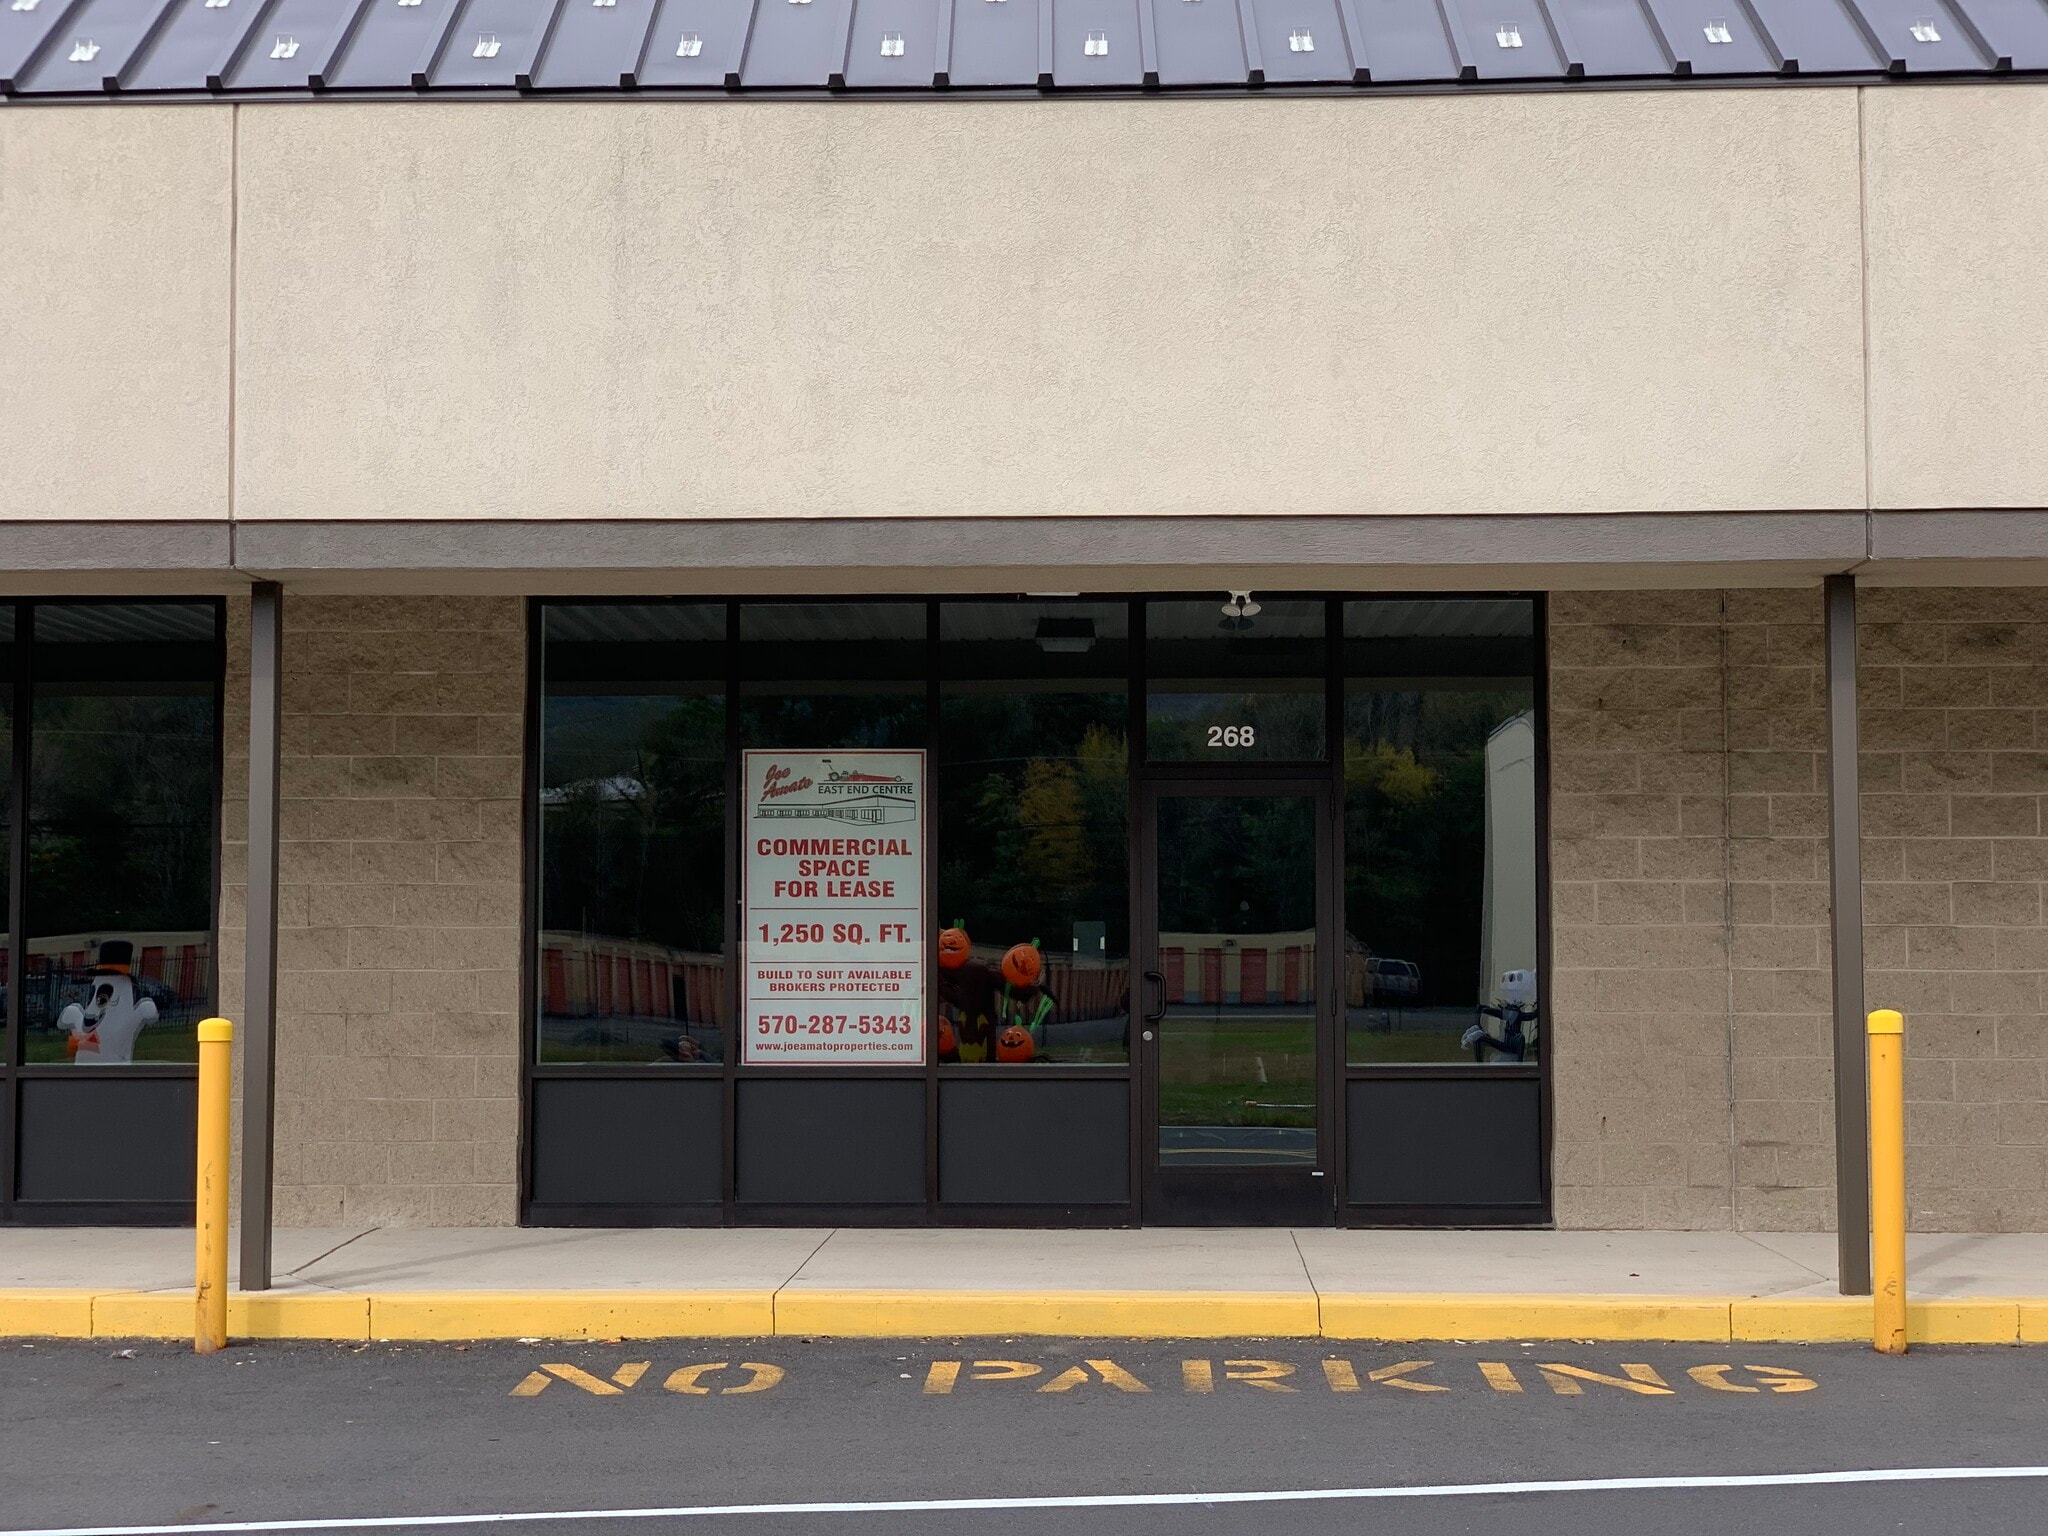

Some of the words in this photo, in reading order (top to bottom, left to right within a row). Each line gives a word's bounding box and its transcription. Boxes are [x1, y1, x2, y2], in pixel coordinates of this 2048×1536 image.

[1207, 726, 1255, 747] 268
[763, 764, 791, 789] Joe
[760, 777, 813, 802] Amato
[818, 785, 844, 794] EAST
[847, 785, 869, 794] END
[872, 785, 912, 794] CENTRE
[757, 839, 912, 856] COMMERCIAL
[799, 860, 869, 877] SPACE
[774, 881, 818, 897] FOR
[828, 881, 894, 897] LEASE
[758, 923, 823, 946] 1,250
[833, 923, 871, 945] SQ.
[880, 924, 911, 943] FT.
[758, 970, 793, 979] BUILD
[797, 970, 812, 979] TO
[817, 970, 843, 979] SUIT
[848, 970, 911, 979] AVAILABLE
[770, 983, 825, 992] BROKERS
[830, 983, 900, 992] PROTECTED
[758, 1015, 911, 1034] 570-287-5343
[756, 1042, 913, 1051] www.joeamatoproperties.com
[508, 1360, 785, 1396] NO
[922, 1359, 1819, 1395] PARKING
